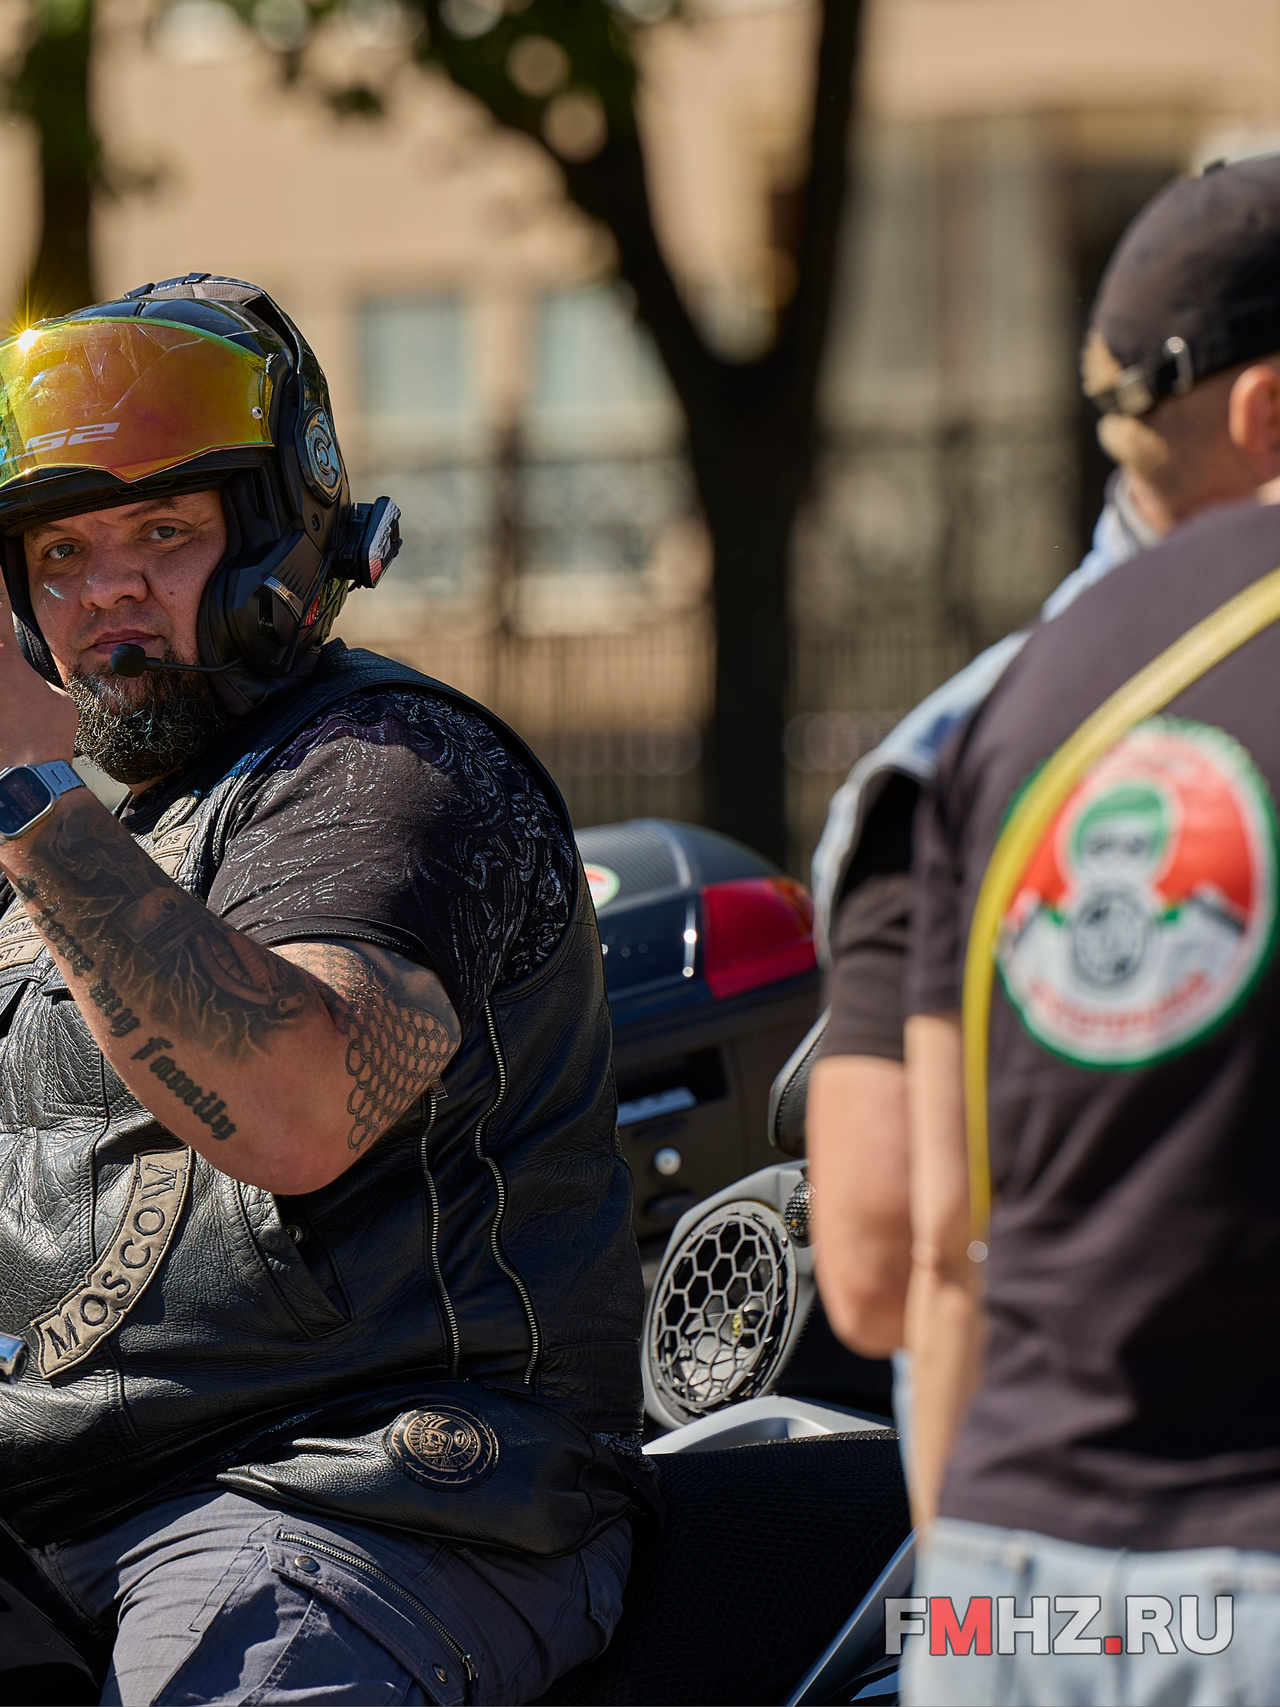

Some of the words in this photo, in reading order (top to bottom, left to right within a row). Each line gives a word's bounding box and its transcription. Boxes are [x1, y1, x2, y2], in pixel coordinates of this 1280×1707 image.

[154, 832, 182, 852] ADS
[89, 979, 140, 1038] my
[130, 1037, 237, 1141] family
[45, 1163, 178, 1360] MOSCOW
